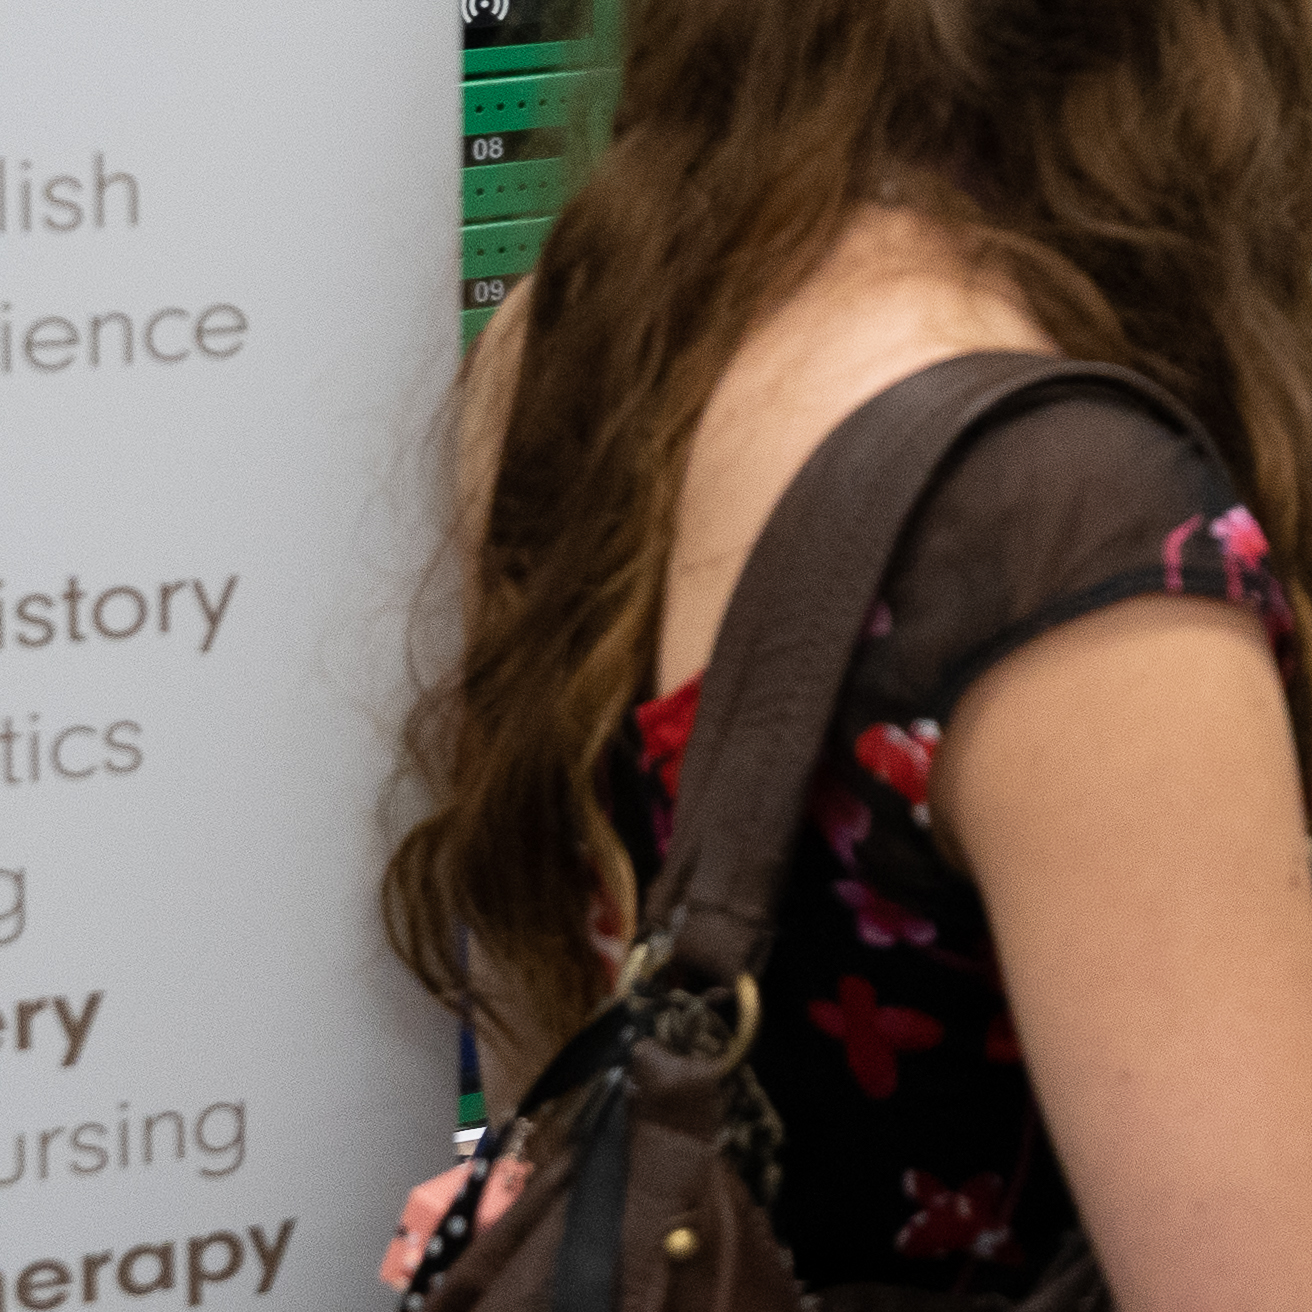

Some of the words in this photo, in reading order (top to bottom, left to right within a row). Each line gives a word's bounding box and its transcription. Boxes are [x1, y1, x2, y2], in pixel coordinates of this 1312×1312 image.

[472, 138, 505, 162] 08
[0, 150, 141, 234] lish
[474, 279, 506, 304] 09
[0, 302, 249, 374] ience
[0, 710, 144, 785] tics
[0, 990, 104, 1068] ry
